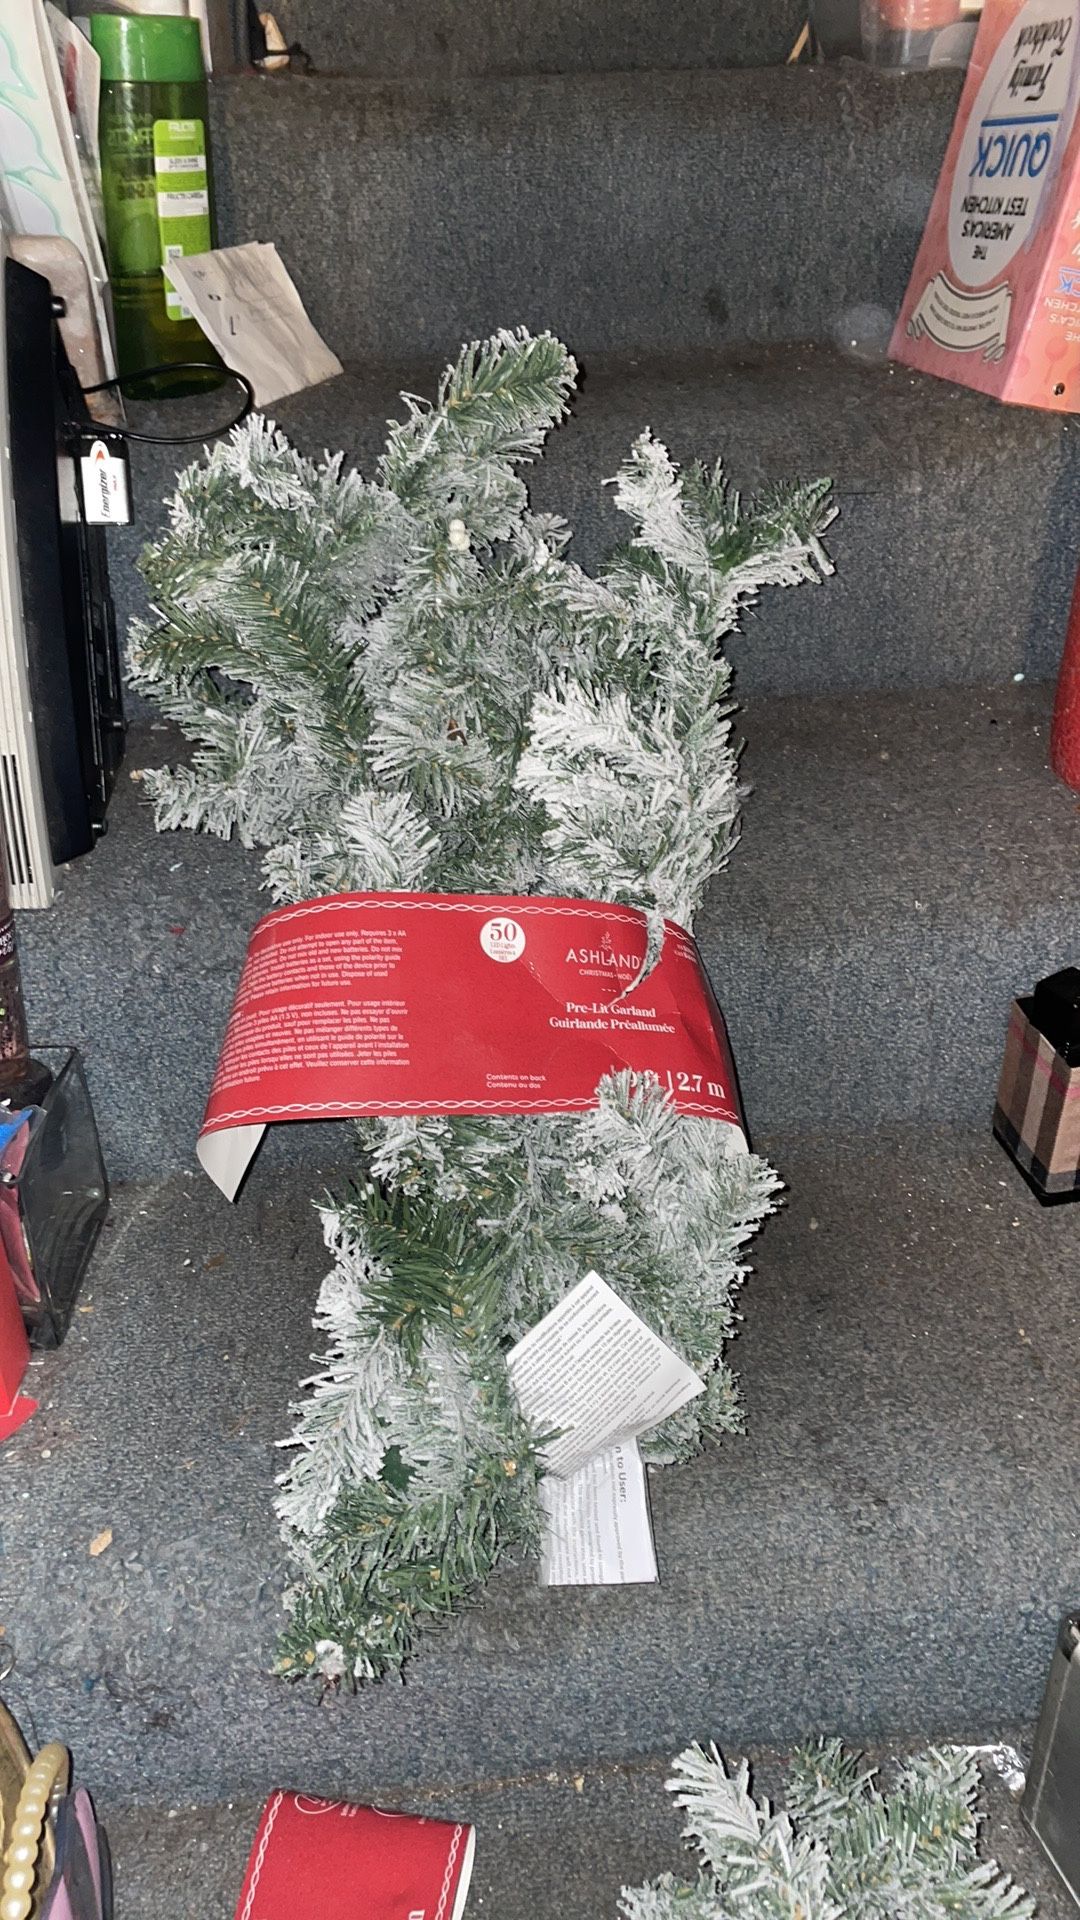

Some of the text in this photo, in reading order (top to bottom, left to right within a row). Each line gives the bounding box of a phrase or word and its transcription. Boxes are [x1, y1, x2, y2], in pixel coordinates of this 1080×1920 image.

[968, 131, 1051, 178] QUICK
[960, 195, 1029, 216] TEST KITCHEN
[961, 219, 1015, 241] AMERICA'S
[972, 245, 988, 260] THE
[1044, 297, 1080, 313] CHEN
[1064, 330, 1080, 342] HE
[99, 468, 111, 518] Energizer
[490, 922, 517, 941] 50
[565, 948, 641, 970] ASHLAND
[566, 1001, 657, 1018] Pre-Lit Garland
[549, 1016, 676, 1034] Guirlande Préallumée
[486, 1073, 519, 1081] Contents
[676, 1071, 703, 1093] 2.7
[706, 1081, 726, 1099] m
[616, 1457, 624, 1469] to
[618, 1472, 627, 1503] User:
